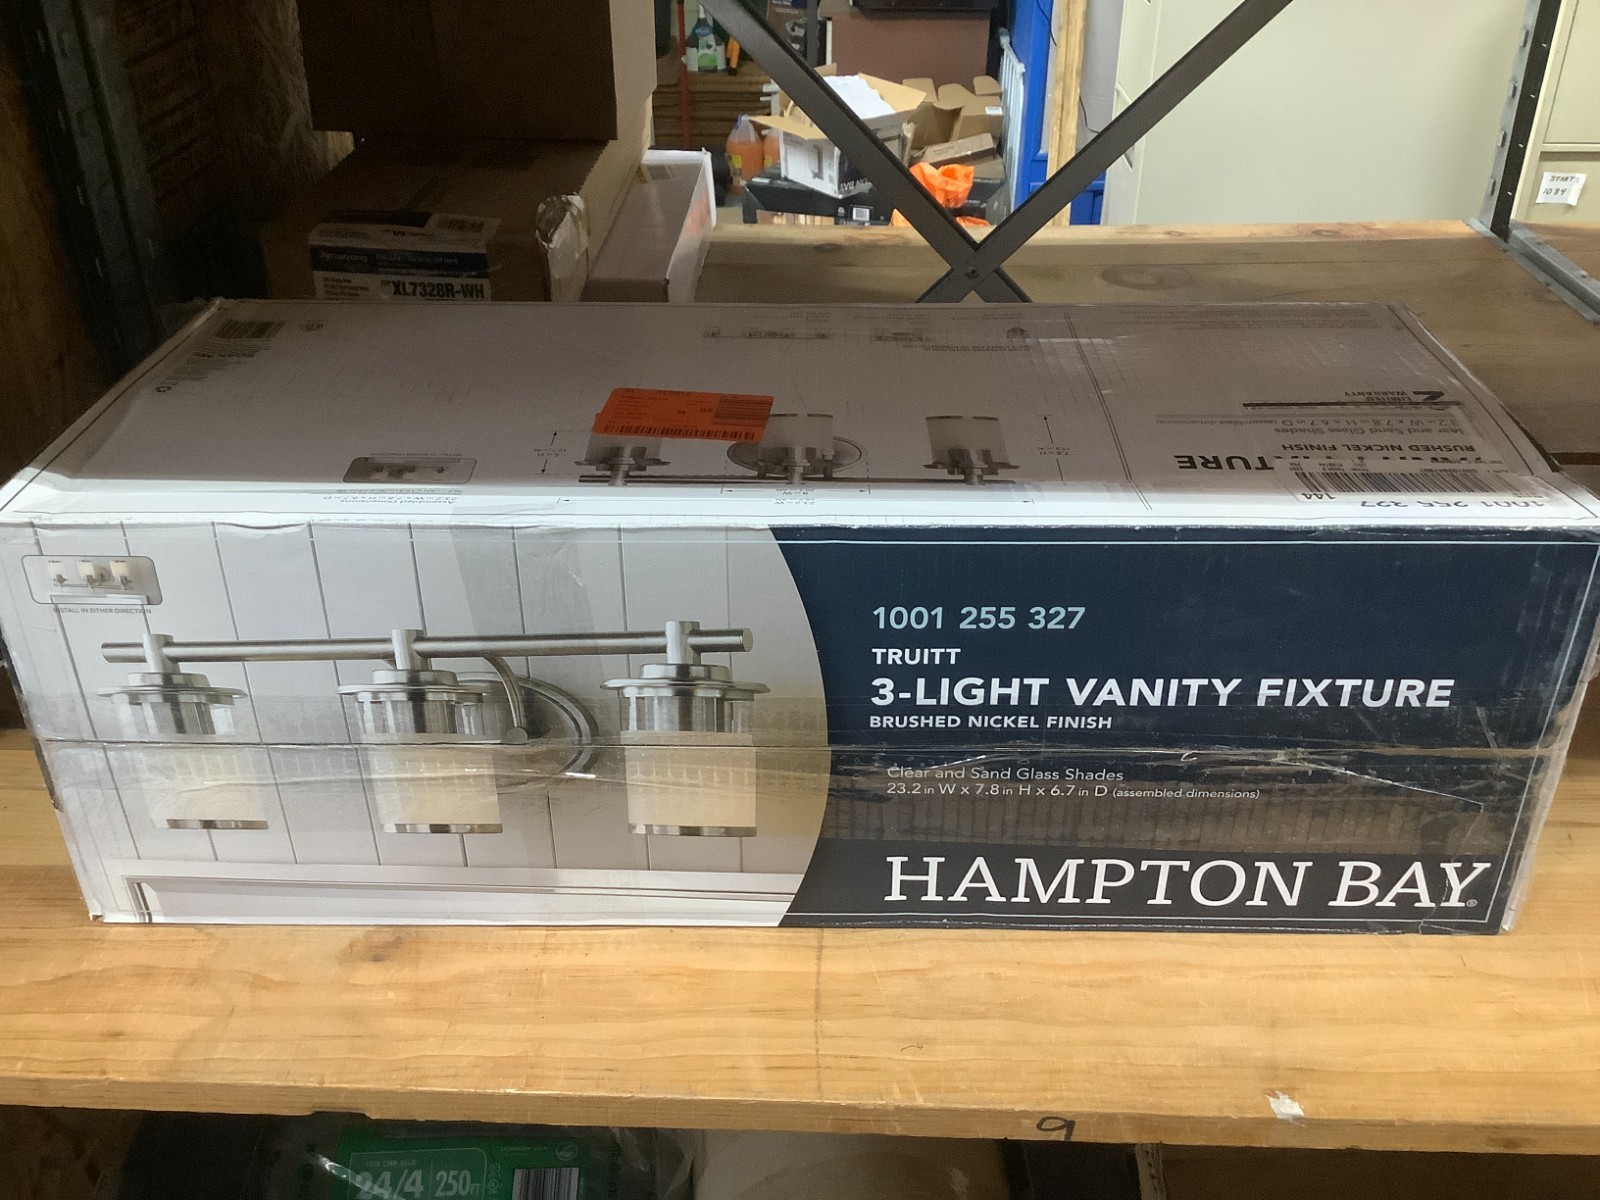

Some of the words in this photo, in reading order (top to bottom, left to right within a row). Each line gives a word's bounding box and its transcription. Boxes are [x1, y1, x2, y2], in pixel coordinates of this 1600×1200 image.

[392, 280, 485, 299] XL7328R-WH
[1281, 443, 1338, 451] FINISH
[1341, 444, 1403, 452] NICKEL
[1408, 444, 1476, 452] RUSHED
[873, 606, 944, 629] 1001
[959, 606, 1016, 629] 255
[1028, 606, 1086, 629] 327
[871, 648, 961, 665] TRUITT
[870, 677, 1050, 706] 3-LIGHT
[1066, 677, 1243, 707] VANITY
[1256, 678, 1455, 708] FIXTURE
[869, 715, 961, 728] BRUSHED
[968, 715, 1039, 728] NICKEL
[1046, 716, 1113, 729] FINISH
[886, 766, 931, 780] Clear
[935, 766, 964, 780] and
[971, 767, 1011, 780] Sand
[1016, 767, 1060, 780] Glass
[1064, 767, 1124, 781] Shades
[886, 782, 922, 795] 23.2
[924, 785, 935, 795] in
[938, 783, 957, 795] W
[961, 786, 970, 795] x
[975, 783, 1000, 796] 7.8
[1002, 785, 1013, 796] in
[1018, 784, 1031, 796] H
[1036, 787, 1046, 796] x
[1050, 784, 1076, 797] 6.7
[1078, 786, 1090, 796] in
[1094, 785, 1108, 797] D
[1112, 786, 1183, 799] (assembled
[1186, 787, 1261, 800] dimensions)
[884, 855, 1313, 907] HAMPTON
